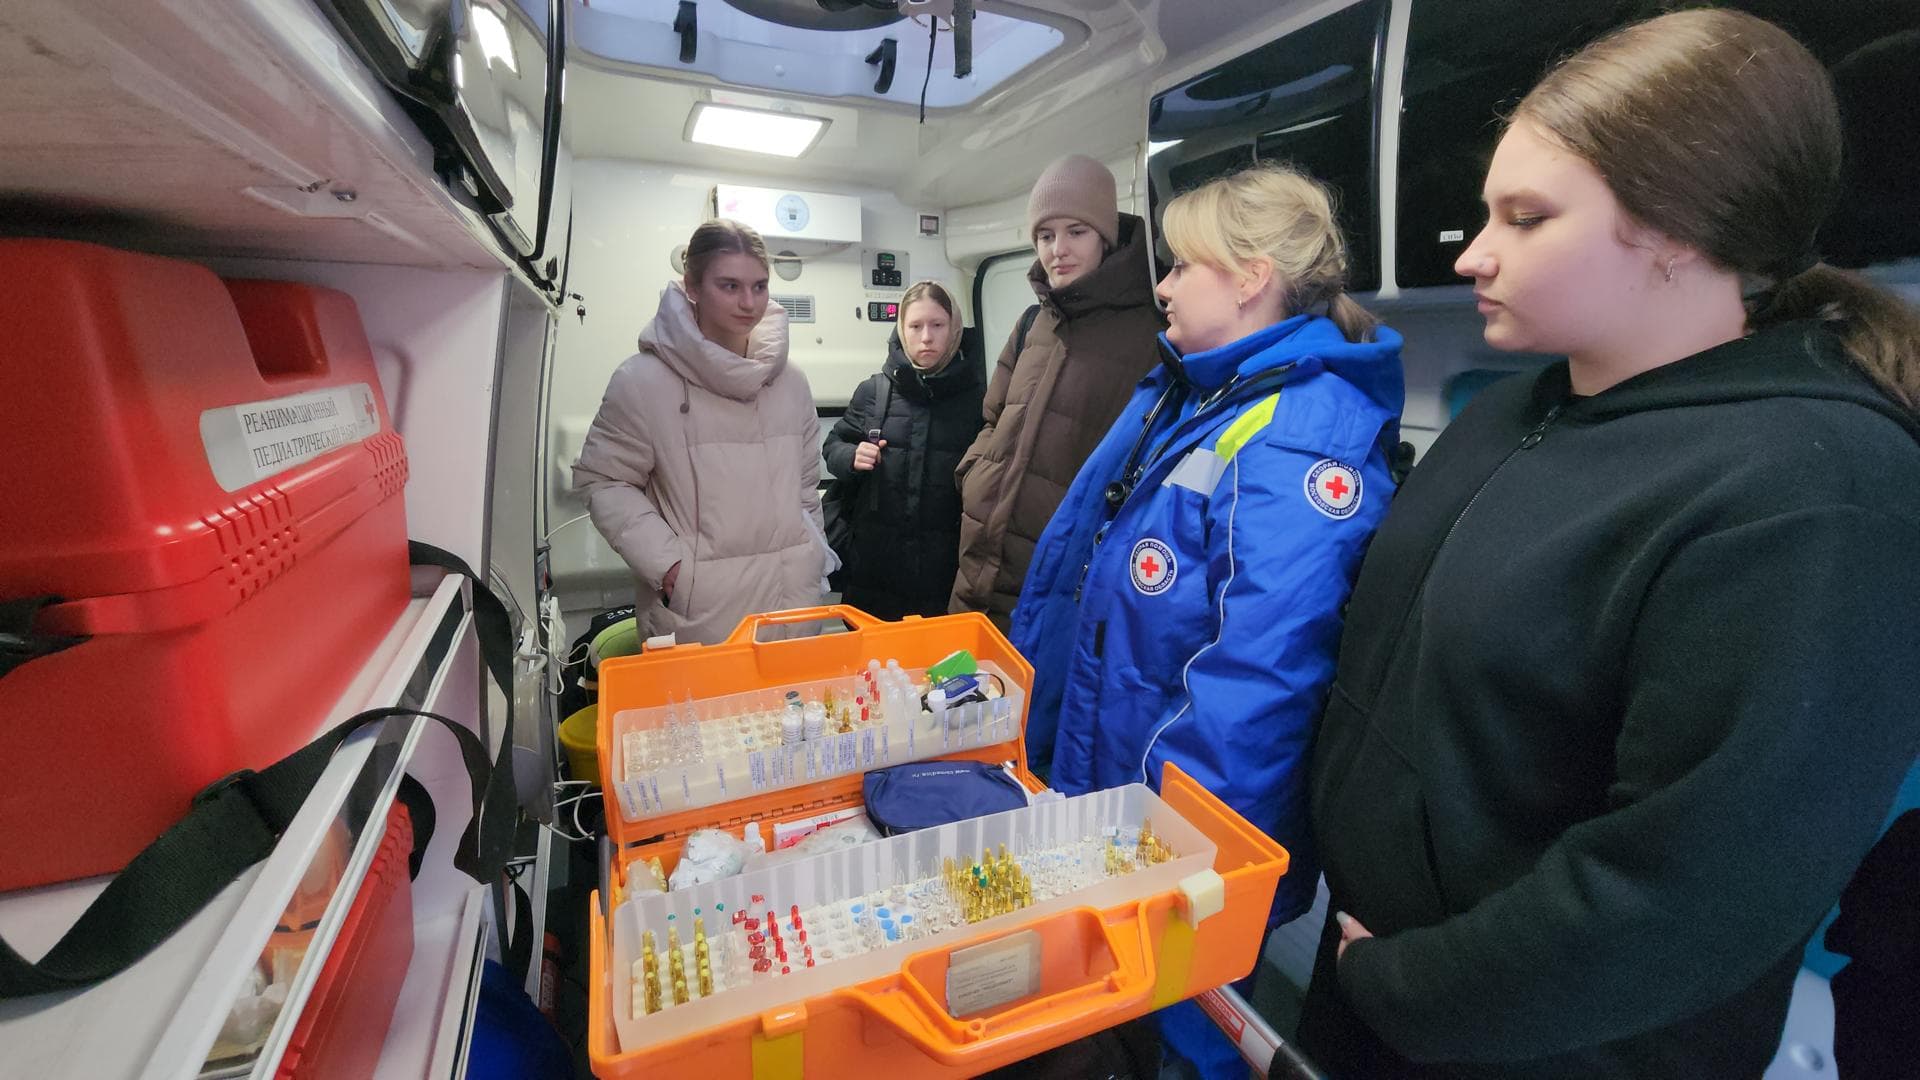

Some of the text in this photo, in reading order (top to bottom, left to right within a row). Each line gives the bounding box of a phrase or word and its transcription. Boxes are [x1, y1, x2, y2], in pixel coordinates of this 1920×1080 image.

[243, 396, 339, 434] РЕАНИМАЦИОННЫЙ
[253, 424, 340, 468] ПЕДИАТРИЧЕСКИЙ
[1311, 461, 1338, 478] СКОРАЯ
[1308, 482, 1340, 515] МОСКОВСКАЯ
